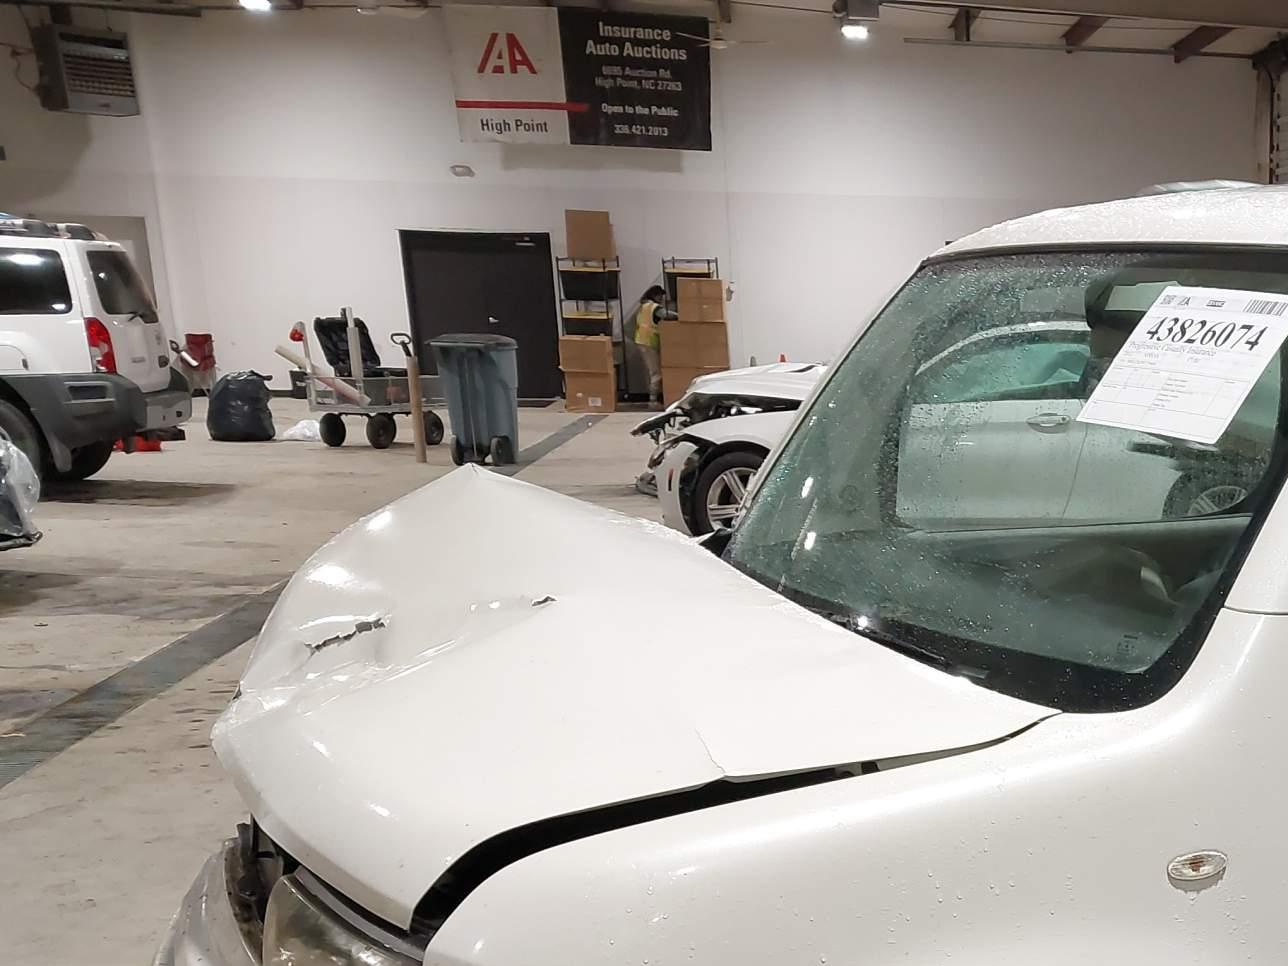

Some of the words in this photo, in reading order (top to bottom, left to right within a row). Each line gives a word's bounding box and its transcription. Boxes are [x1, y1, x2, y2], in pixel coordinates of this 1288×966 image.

[598, 21, 671, 40] Insurance
[585, 39, 619, 56] Auto
[623, 42, 687, 60] Auctions
[624, 66, 657, 78] Auction
[659, 68, 672, 79] Rd.
[595, 76, 614, 88] High
[617, 78, 640, 89] Point,
[642, 79, 655, 90] NC
[601, 103, 623, 115] Open
[625, 104, 634, 114] to
[635, 105, 649, 115] the
[651, 106, 679, 117] Public
[480, 118, 511, 135] High
[515, 119, 548, 133] Point
[1146, 316, 1269, 351] 43826074
